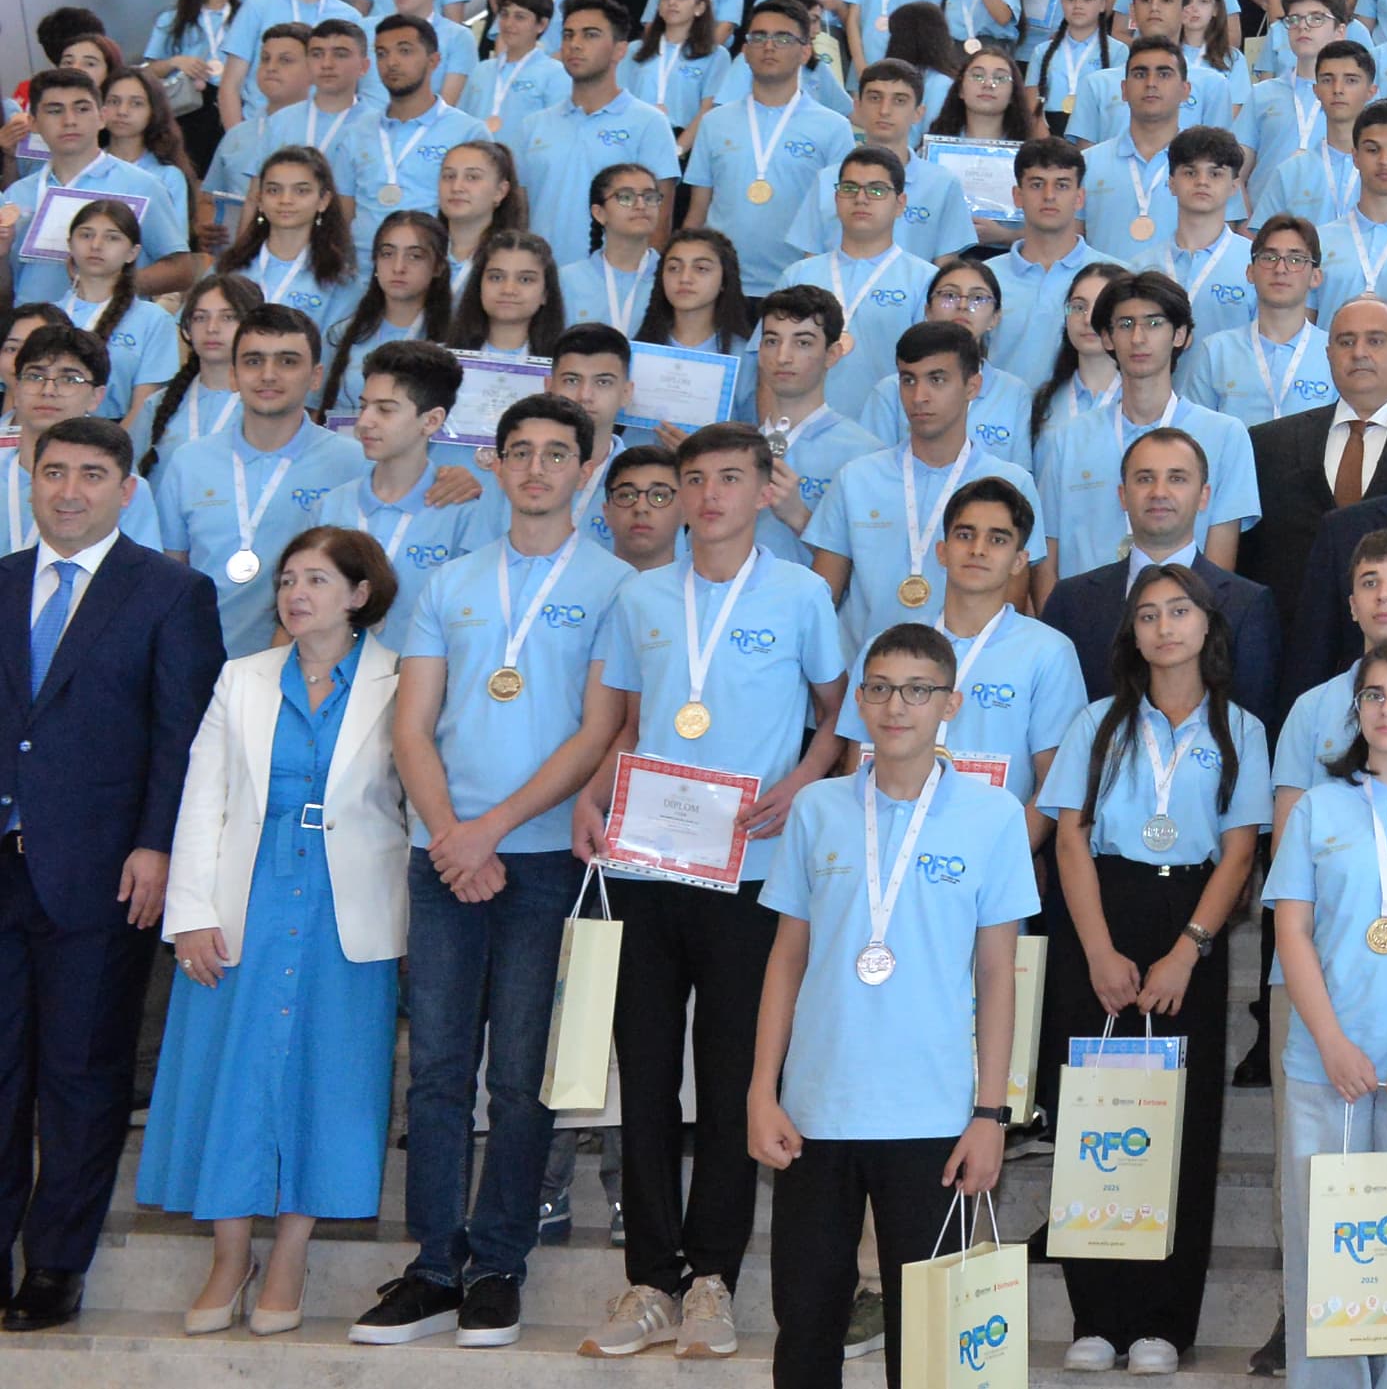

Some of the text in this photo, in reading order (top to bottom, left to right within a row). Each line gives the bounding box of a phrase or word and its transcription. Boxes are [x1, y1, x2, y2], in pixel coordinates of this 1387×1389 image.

[598, 130, 630, 145] RFO
[784, 141, 816, 157] RFO
[904, 206, 930, 224] RFO
[289, 292, 323, 310] RFO
[871, 290, 906, 307] RFO
[1211, 284, 1245, 304] RFO
[110, 332, 136, 346] RFO
[1293, 380, 1328, 400] RFO
[976, 424, 1010, 446] RFO
[406, 544, 448, 568] RFO
[541, 604, 586, 628] RFO
[730, 628, 776, 654] RFO
[971, 683, 1015, 709] RFO
[916, 853, 966, 884] RFO
[1080, 1127, 1151, 1172] RFO
[960, 1315, 1008, 1371] RFO
